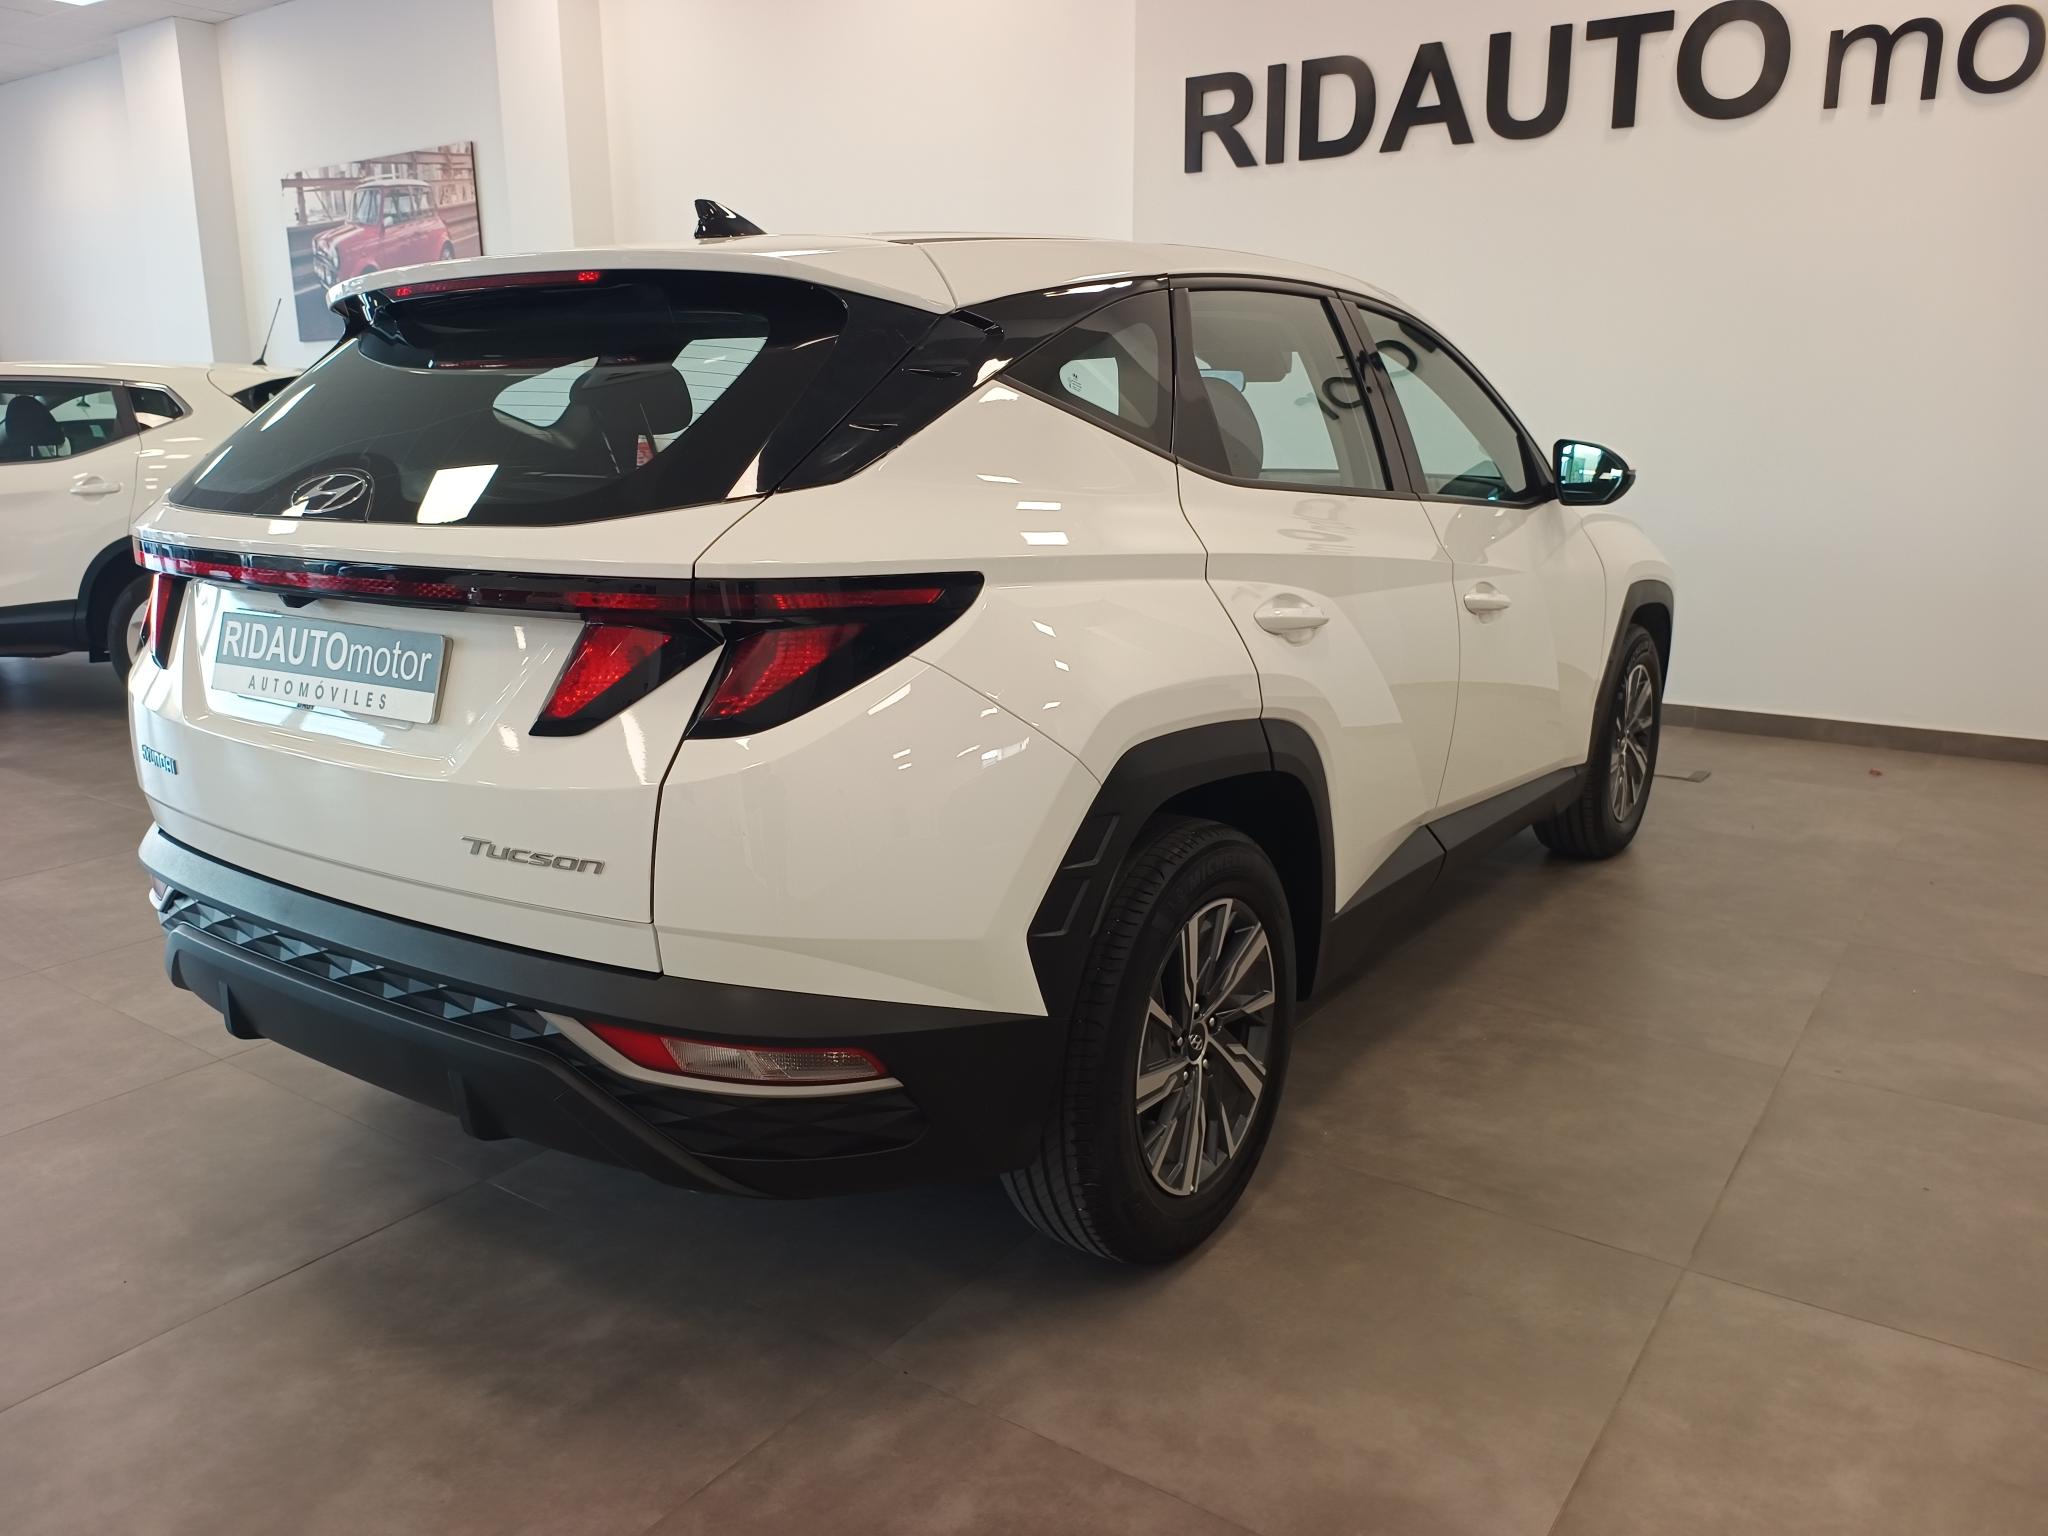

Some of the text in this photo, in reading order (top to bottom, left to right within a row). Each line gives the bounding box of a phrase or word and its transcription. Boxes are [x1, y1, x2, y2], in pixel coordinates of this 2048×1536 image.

[1185, 0, 1791, 173] RIDAUTO
[222, 620, 432, 682] RIDAUTOmotor
[248, 675, 387, 710] AUTOMÓVILES
